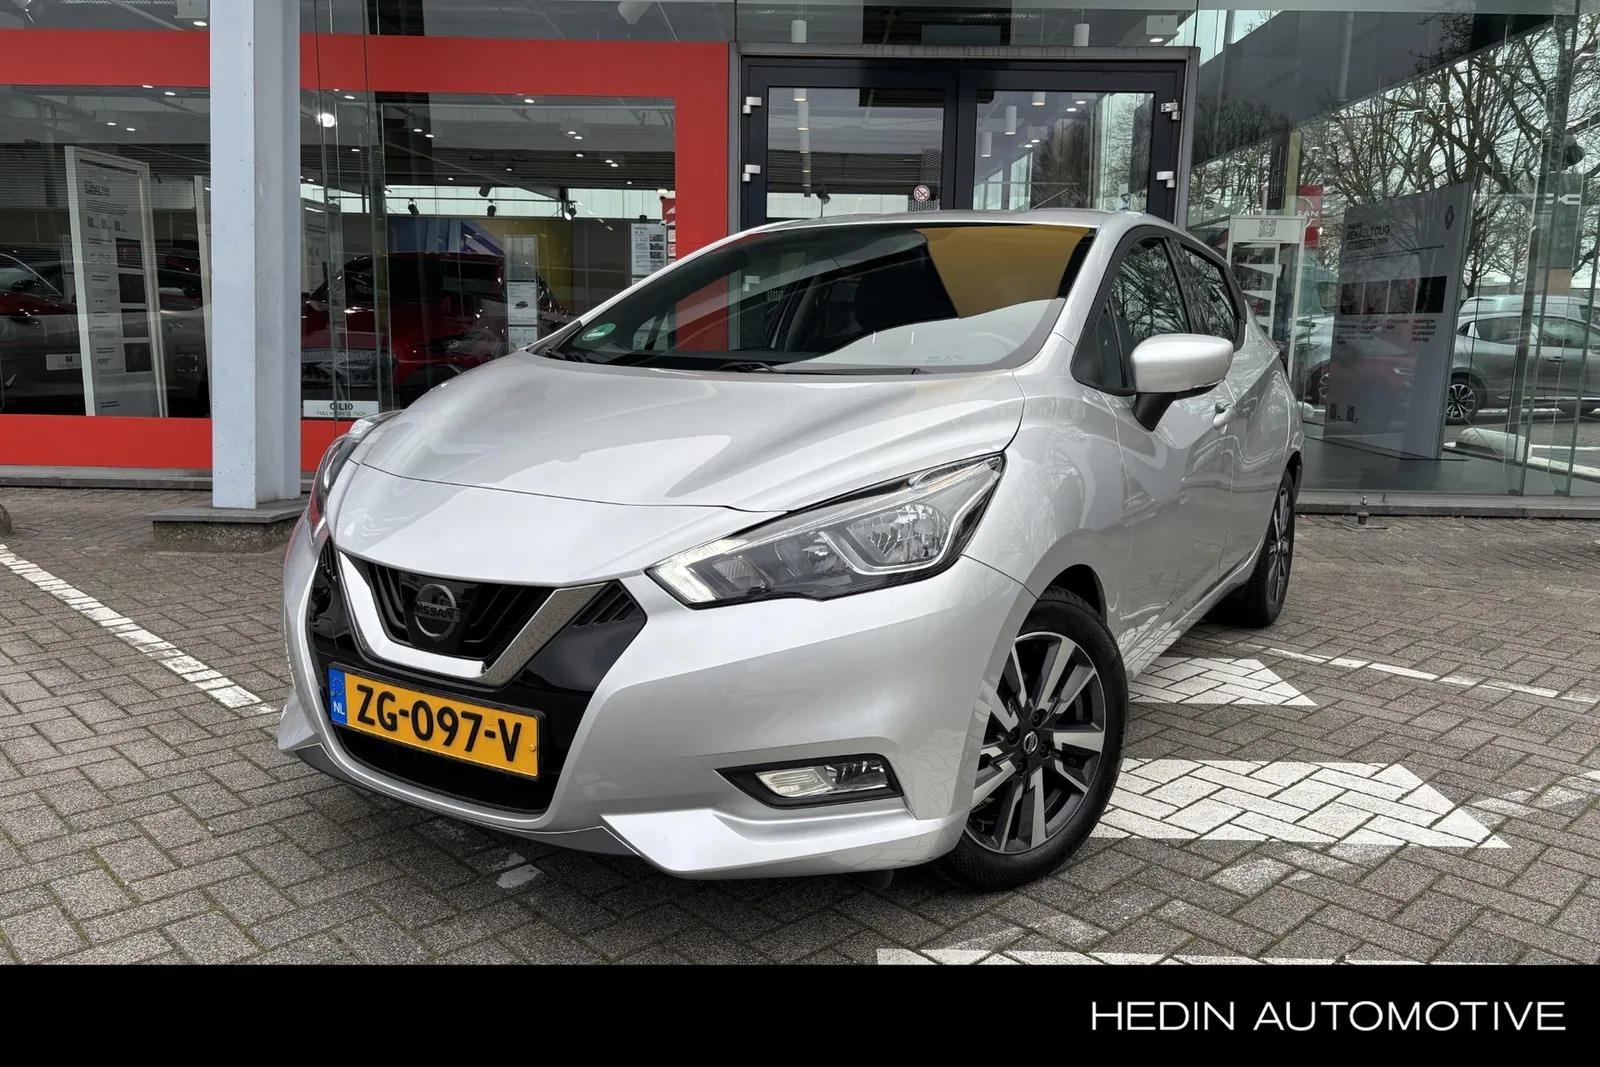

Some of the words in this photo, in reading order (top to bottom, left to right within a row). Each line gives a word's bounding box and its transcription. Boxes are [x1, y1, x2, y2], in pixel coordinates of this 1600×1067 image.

[414, 602, 454, 619] NISSAN
[333, 701, 345, 716] NL
[357, 684, 522, 762] ZG-097-V
